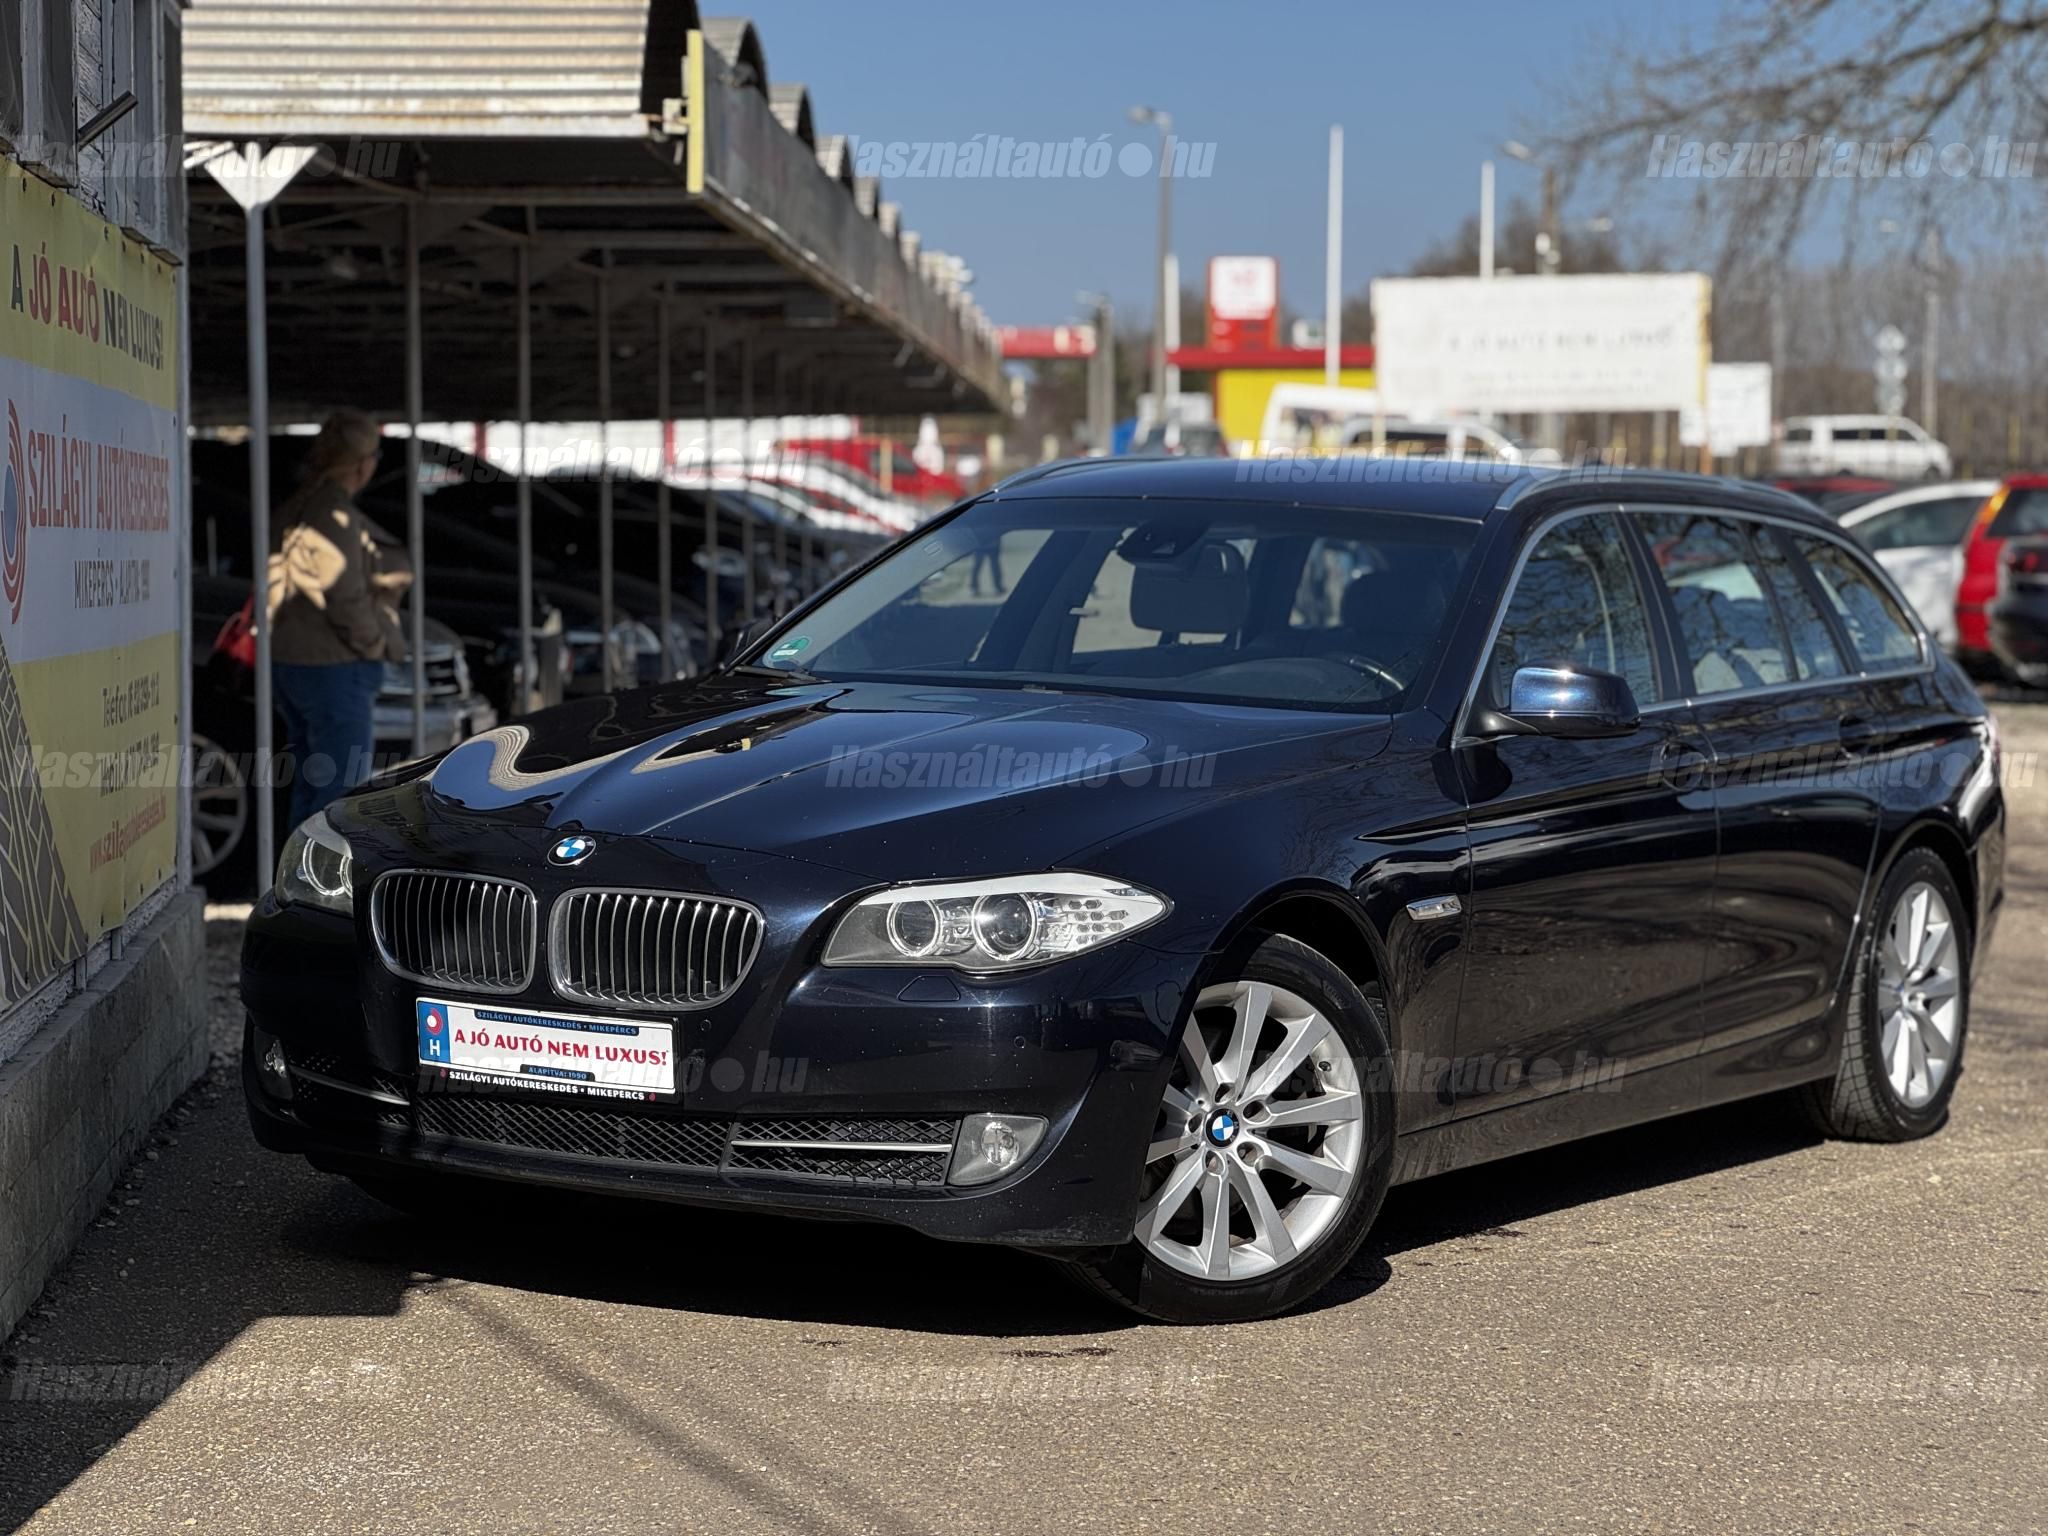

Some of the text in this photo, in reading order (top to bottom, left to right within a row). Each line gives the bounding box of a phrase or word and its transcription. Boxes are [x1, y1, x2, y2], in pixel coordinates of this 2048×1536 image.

[11, 244, 24, 313] A
[29, 240, 52, 325] JÓ
[58, 265, 100, 343] AUTÓ
[103, 288, 129, 355] NEM
[28, 414, 92, 529] SZILÁGYI
[477, 1011, 637, 1035] SZILÁGYI AUTÓKERESKEDÉS MIKEPÉRCS
[429, 1039, 441, 1057] H
[454, 1029, 667, 1066] A JÓ AUTÓ NEM LUXUS!
[450, 1071, 491, 1084] SZILÁGYI
